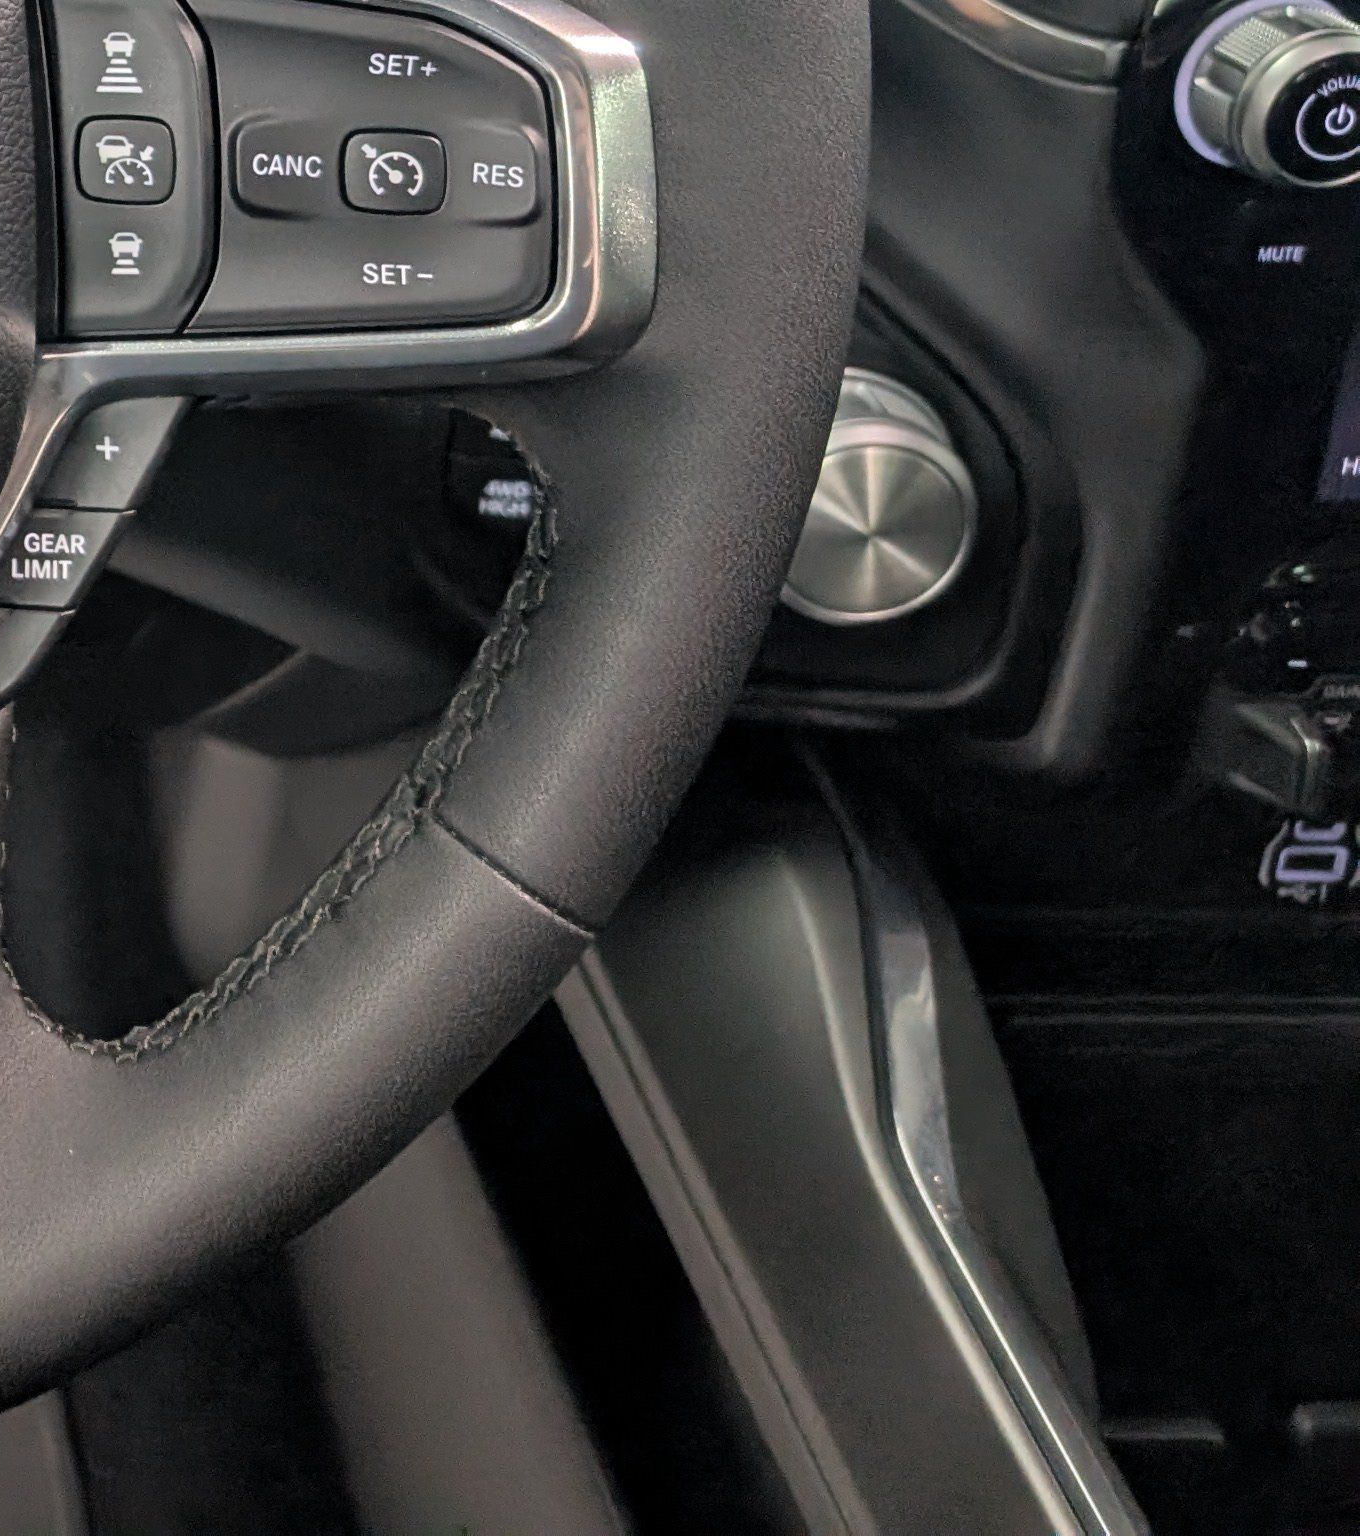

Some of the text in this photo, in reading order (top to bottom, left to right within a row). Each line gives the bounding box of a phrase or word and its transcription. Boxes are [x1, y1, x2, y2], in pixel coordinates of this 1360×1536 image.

[1317, 74, 1360, 98] VOLU
[252, 153, 322, 178] CANC
[472, 162, 524, 188] RES
[1258, 246, 1306, 263] MUTE
[483, 480, 532, 496] 4WD
[24, 532, 85, 555] GEAR
[11, 558, 73, 580] LIMIT
